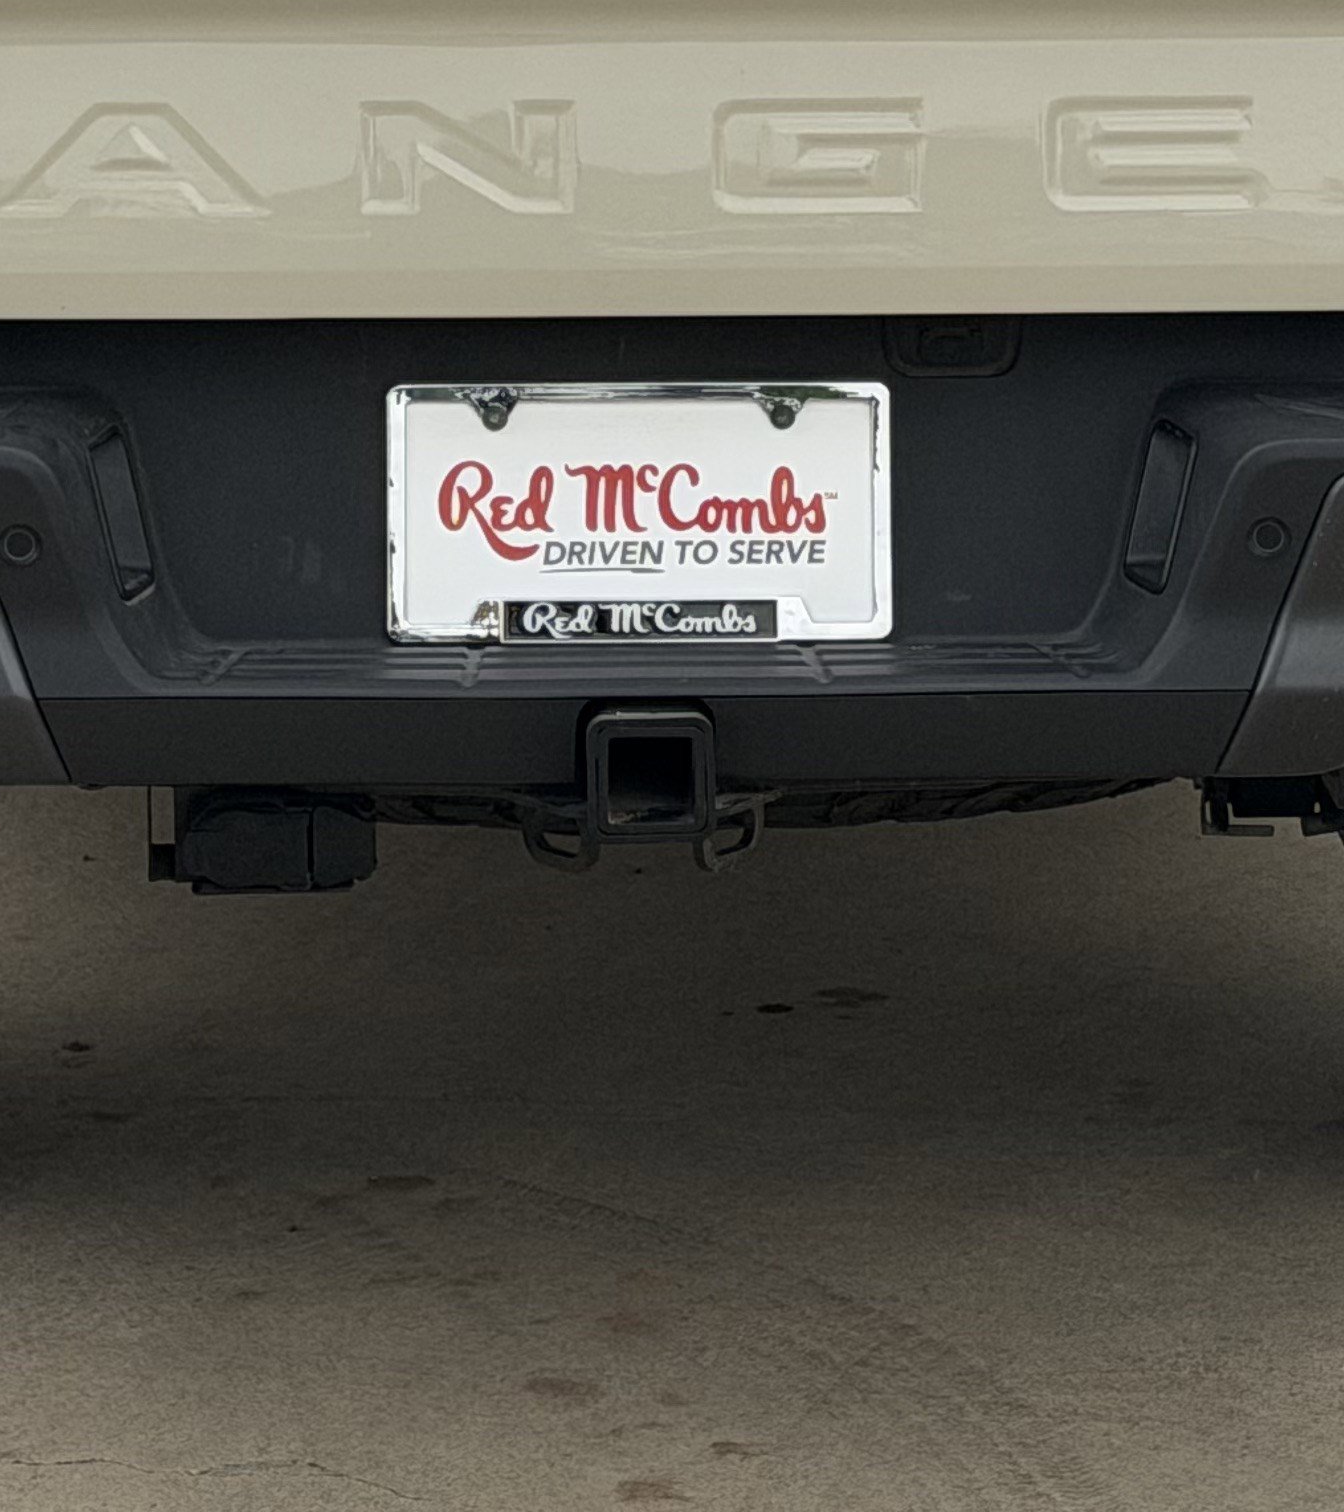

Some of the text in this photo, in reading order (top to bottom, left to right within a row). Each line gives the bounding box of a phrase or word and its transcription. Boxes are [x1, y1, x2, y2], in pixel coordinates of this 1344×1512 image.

[438, 460, 827, 561] Red McCombs
[542, 539, 827, 566] DRIVEN TO SERVE
[522, 602, 757, 639] Red McCombs
